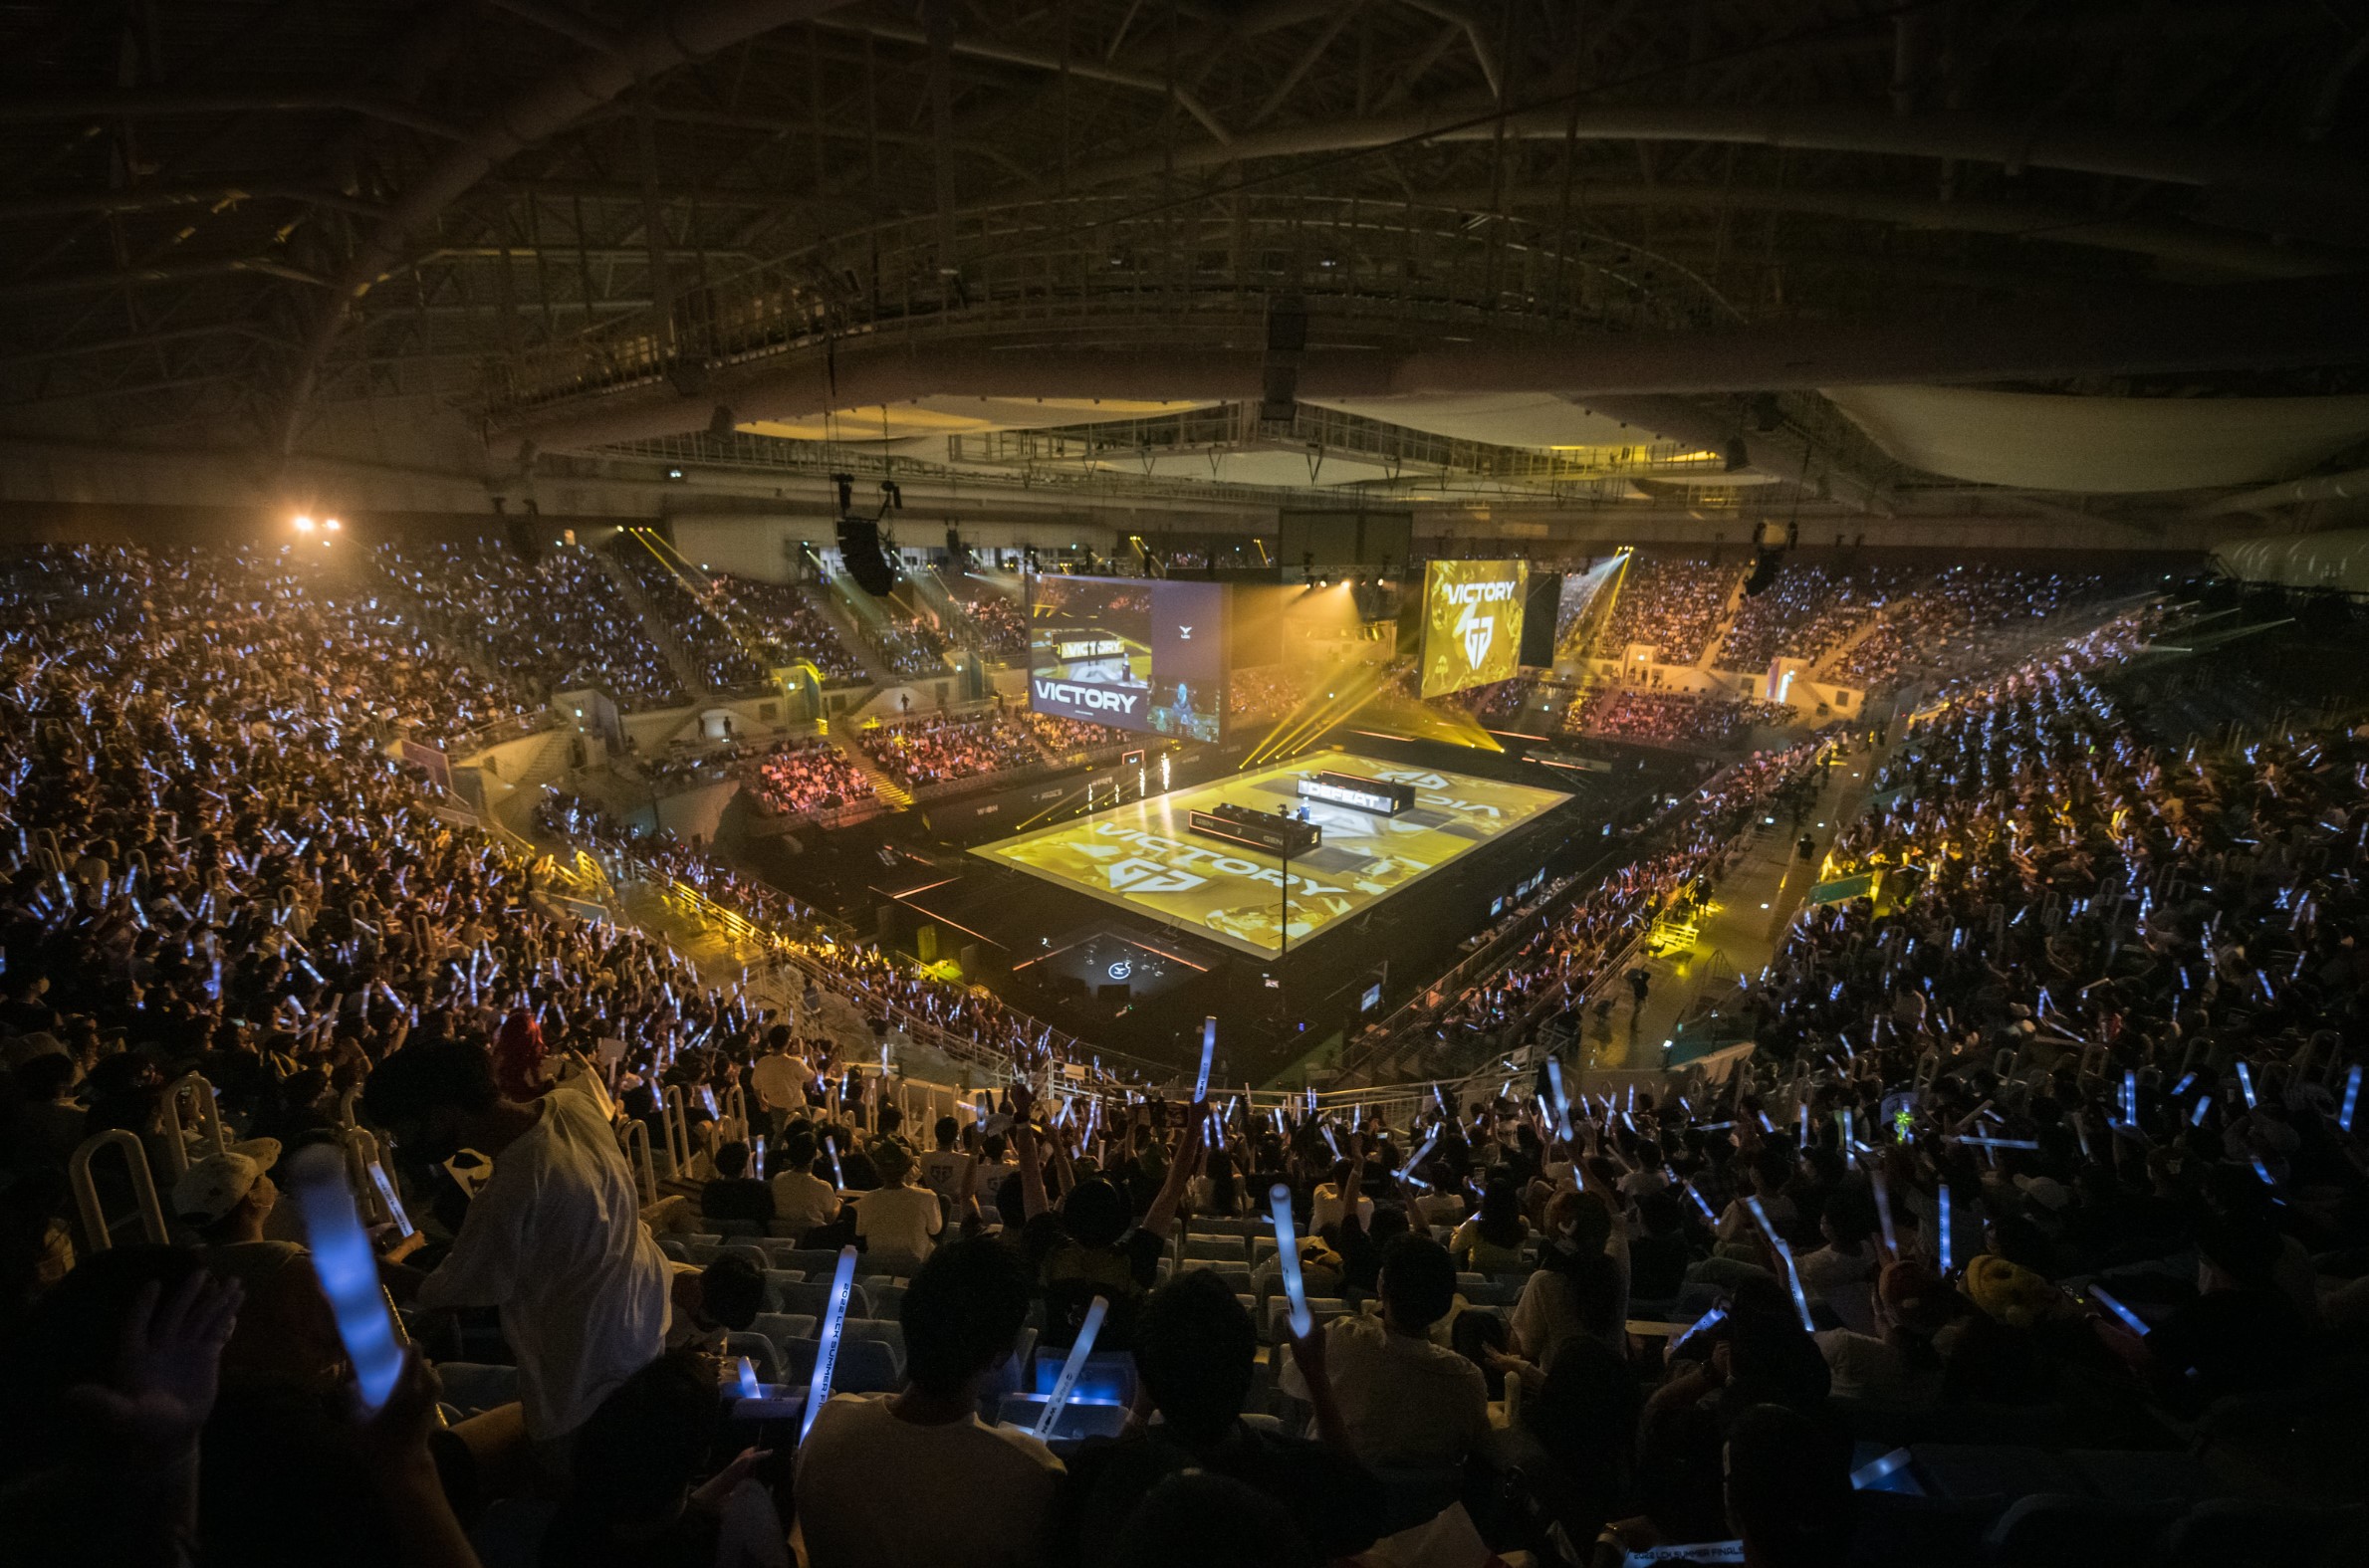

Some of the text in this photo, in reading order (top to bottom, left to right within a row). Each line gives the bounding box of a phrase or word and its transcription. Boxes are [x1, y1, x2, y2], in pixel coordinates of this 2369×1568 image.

[1447, 580, 1517, 604] VICTORY
[1035, 680, 1138, 714] VICTORY
[1307, 781, 1380, 808] DEFEAT
[1096, 821, 1349, 897] VICTORY
[837, 1282, 849, 1313] 2022
[832, 1316, 843, 1338] LCK
[822, 1341, 837, 1392] SUMMER
[1712, 1546, 1744, 1556] FINALS
